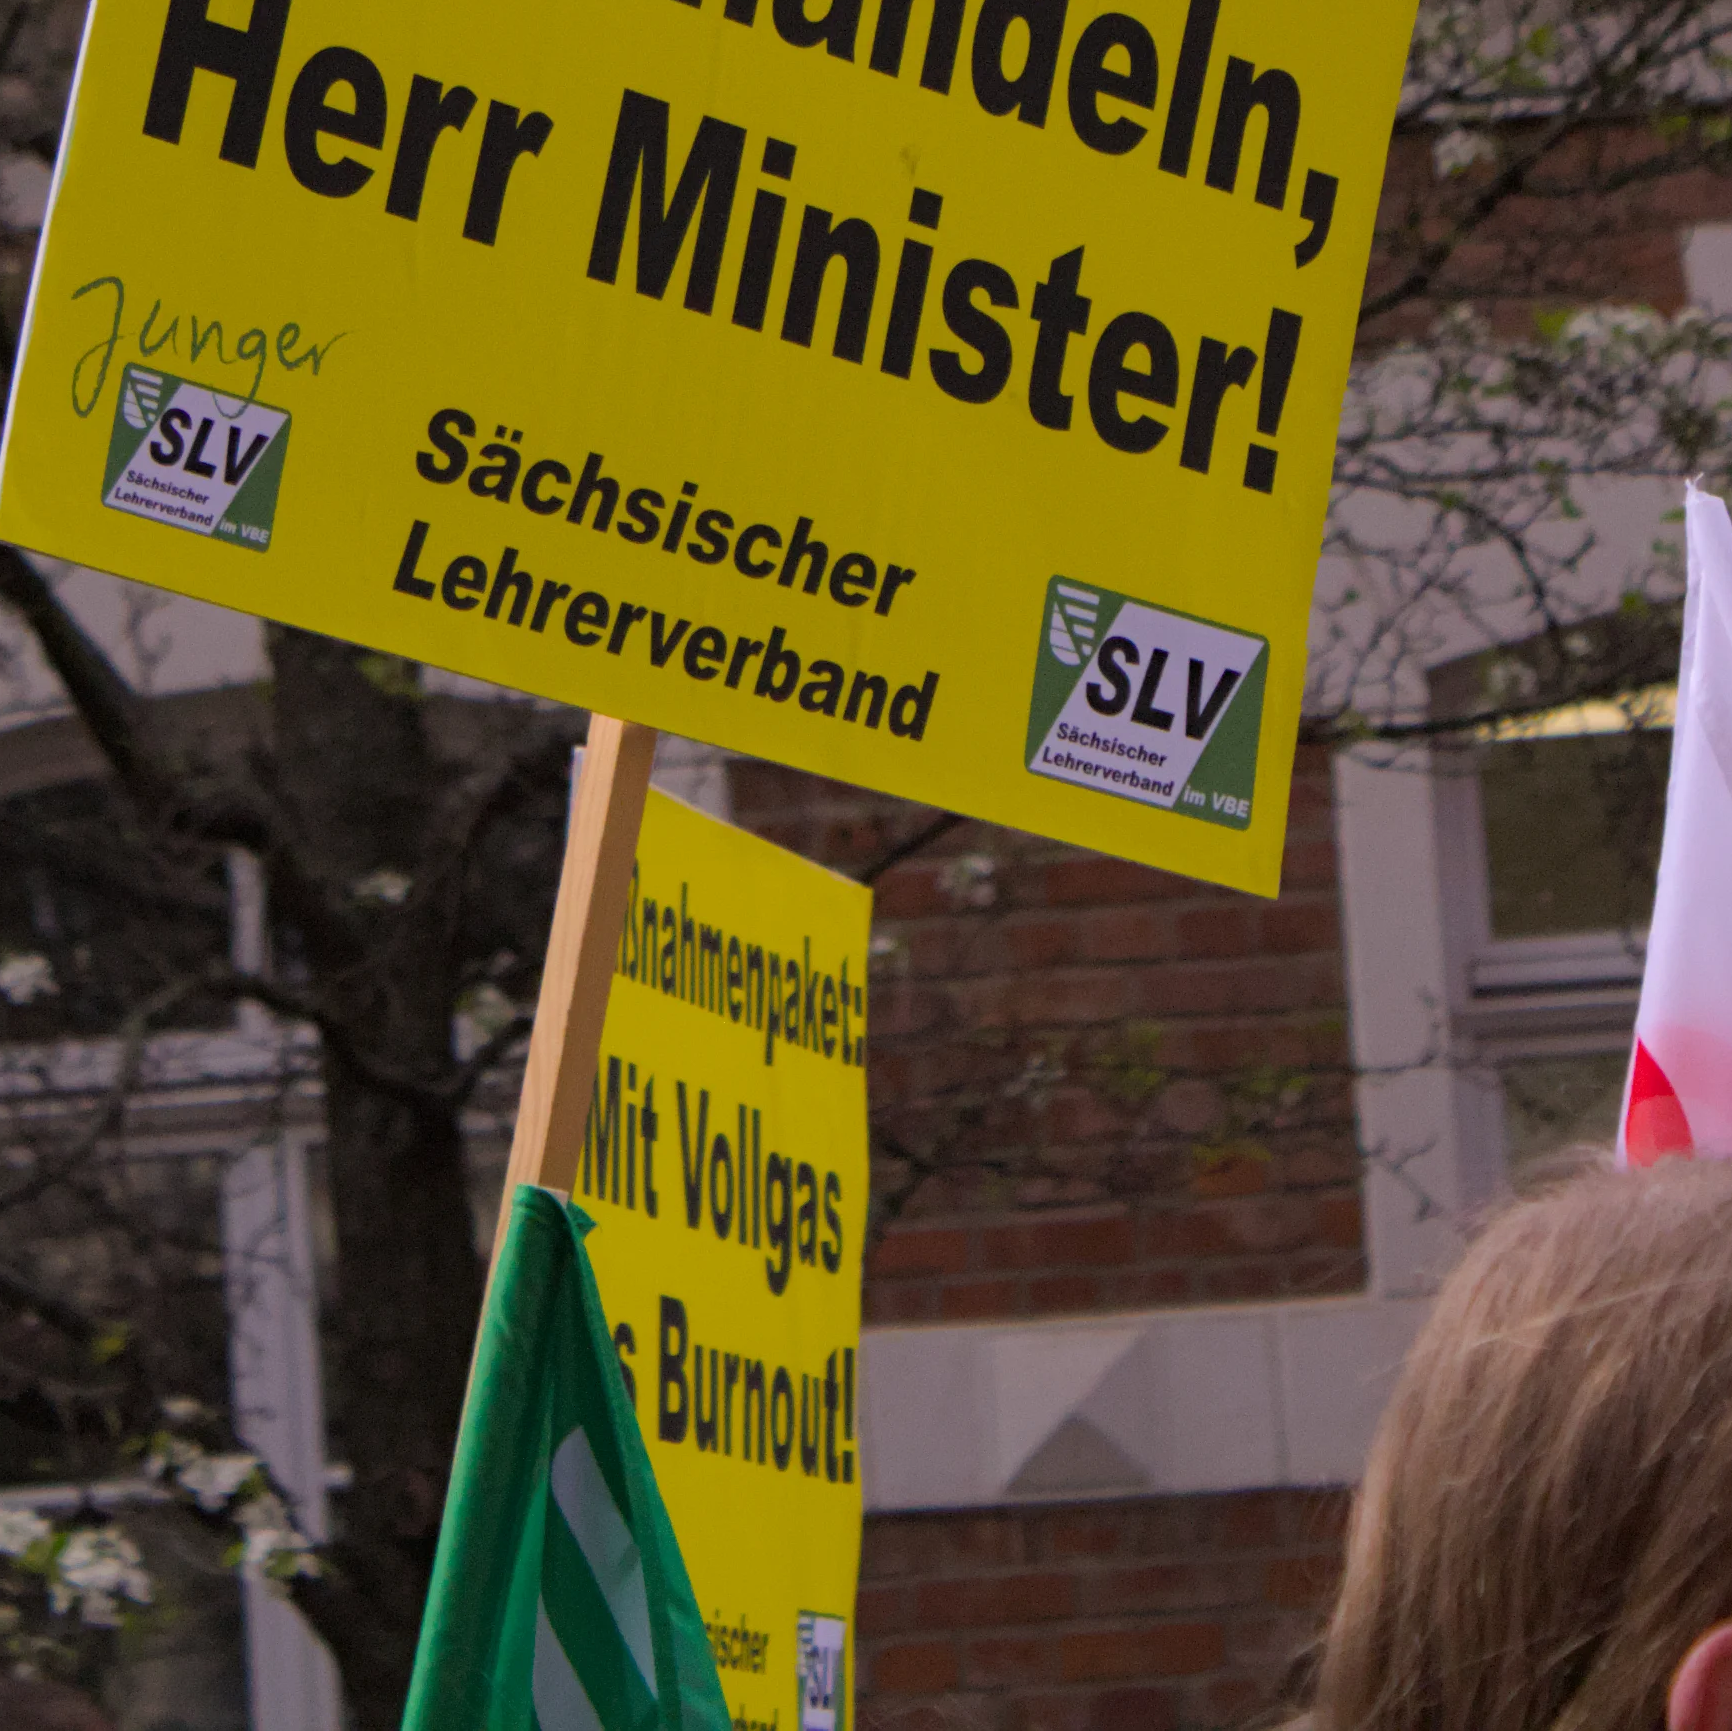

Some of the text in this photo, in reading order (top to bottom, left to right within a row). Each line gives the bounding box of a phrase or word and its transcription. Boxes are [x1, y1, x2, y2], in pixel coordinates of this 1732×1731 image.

[587, 89, 1302, 494] Minister!
[71, 276, 355, 419] Junger
[125, 469, 210, 506] Sächsischer
[149, 408, 269, 486] SLV
[113, 487, 215, 527] Lehrerverband
[219, 519, 269, 544] im VBE
[416, 409, 916, 616] Sächsischer
[393, 520, 939, 741] Lehrerverband
[1085, 635, 1241, 741] SLV
[1041, 745, 1175, 797] Lehrerverband
[1056, 722, 1168, 767] Sächsischer
[1183, 784, 1250, 818] im VBE
[615, 857, 865, 1068] ßnahmenpaket:
[582, 1054, 844, 1297] Mit Vollgas
[658, 1294, 855, 1485] Burnout!
